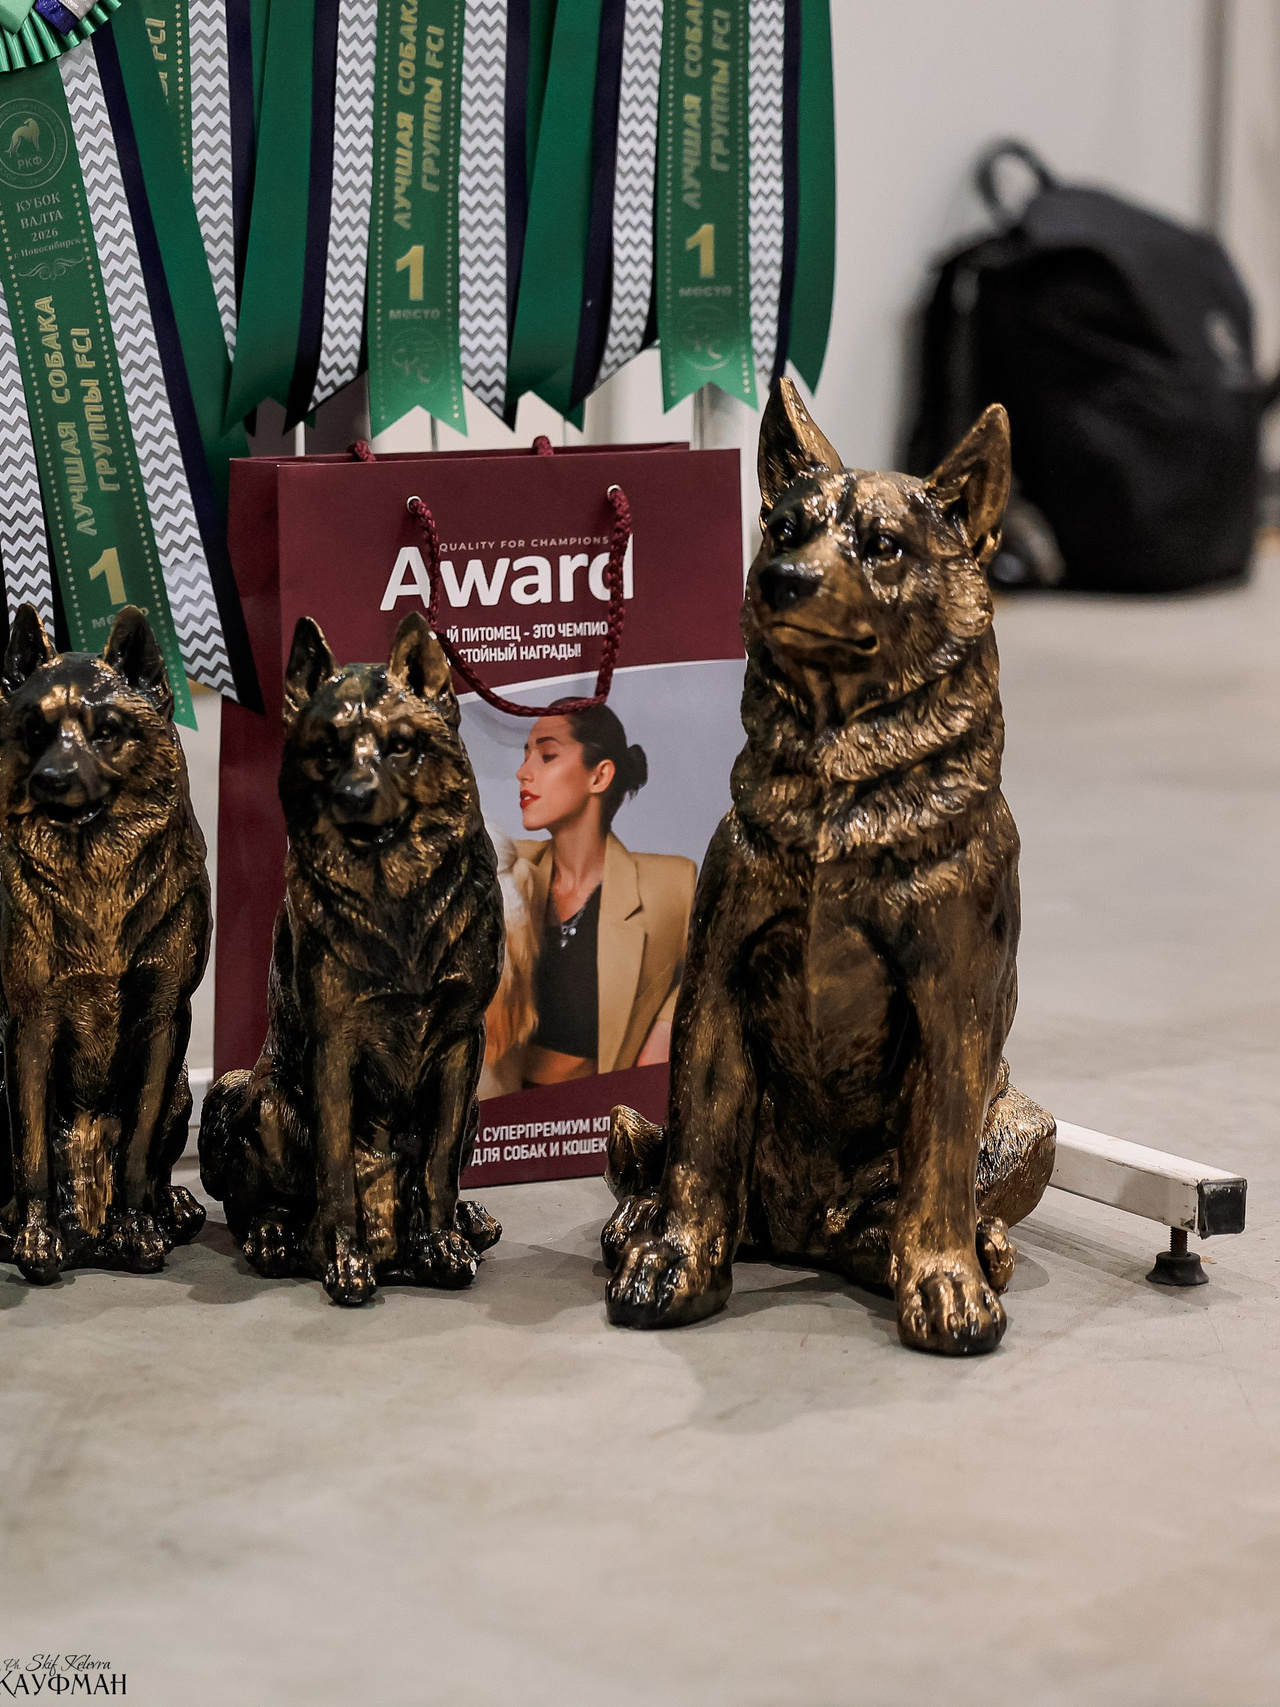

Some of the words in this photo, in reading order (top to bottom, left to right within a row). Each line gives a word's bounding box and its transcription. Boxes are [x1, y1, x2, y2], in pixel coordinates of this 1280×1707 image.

[397, 0, 418, 95] СОБАК
[425, 25, 445, 69] FCI
[711, 8, 731, 50] FCI
[422, 76, 443, 192] ГРУППЫ
[710, 58, 731, 172] ГРУППЫ
[17, 155, 43, 171] РКФ
[394, 111, 414, 230] ЛУЧШАЯ
[682, 93, 703, 210] ЛУЧШАЯ
[16, 192, 61, 213] КУБОК
[20, 209, 63, 229] ВАЛТА
[20, 238, 82, 258] Новосибирск
[31, 228, 59, 242] 2026
[685, 223, 715, 279] 1
[395, 245, 424, 301] 1
[34, 295, 71, 404] СОБАКА
[70, 328, 97, 369] FCI
[80, 379, 121, 492] ГРУППЫ
[57, 421, 98, 536] ЛУЧШАЯ
[439, 541, 496, 553] QUALITY
[500, 539, 526, 549] FOR
[530, 536, 610, 548] CHAMPIONS
[88, 547, 127, 606] 1
[379, 533, 634, 611] Award
[462, 625, 521, 642] ПИТОМЕЦ
[532, 623, 556, 639] ЭТО
[520, 643, 582, 662] НАГРАДЫ!
[470, 1147, 501, 1167] ДЛЯ
[503, 1143, 547, 1162] СОБАК
[549, 1142, 560, 1157] И
[562, 1136, 608, 1156] КОШЕК
[482, 1120, 590, 1143] СУПЕРПРЕМИУМ
